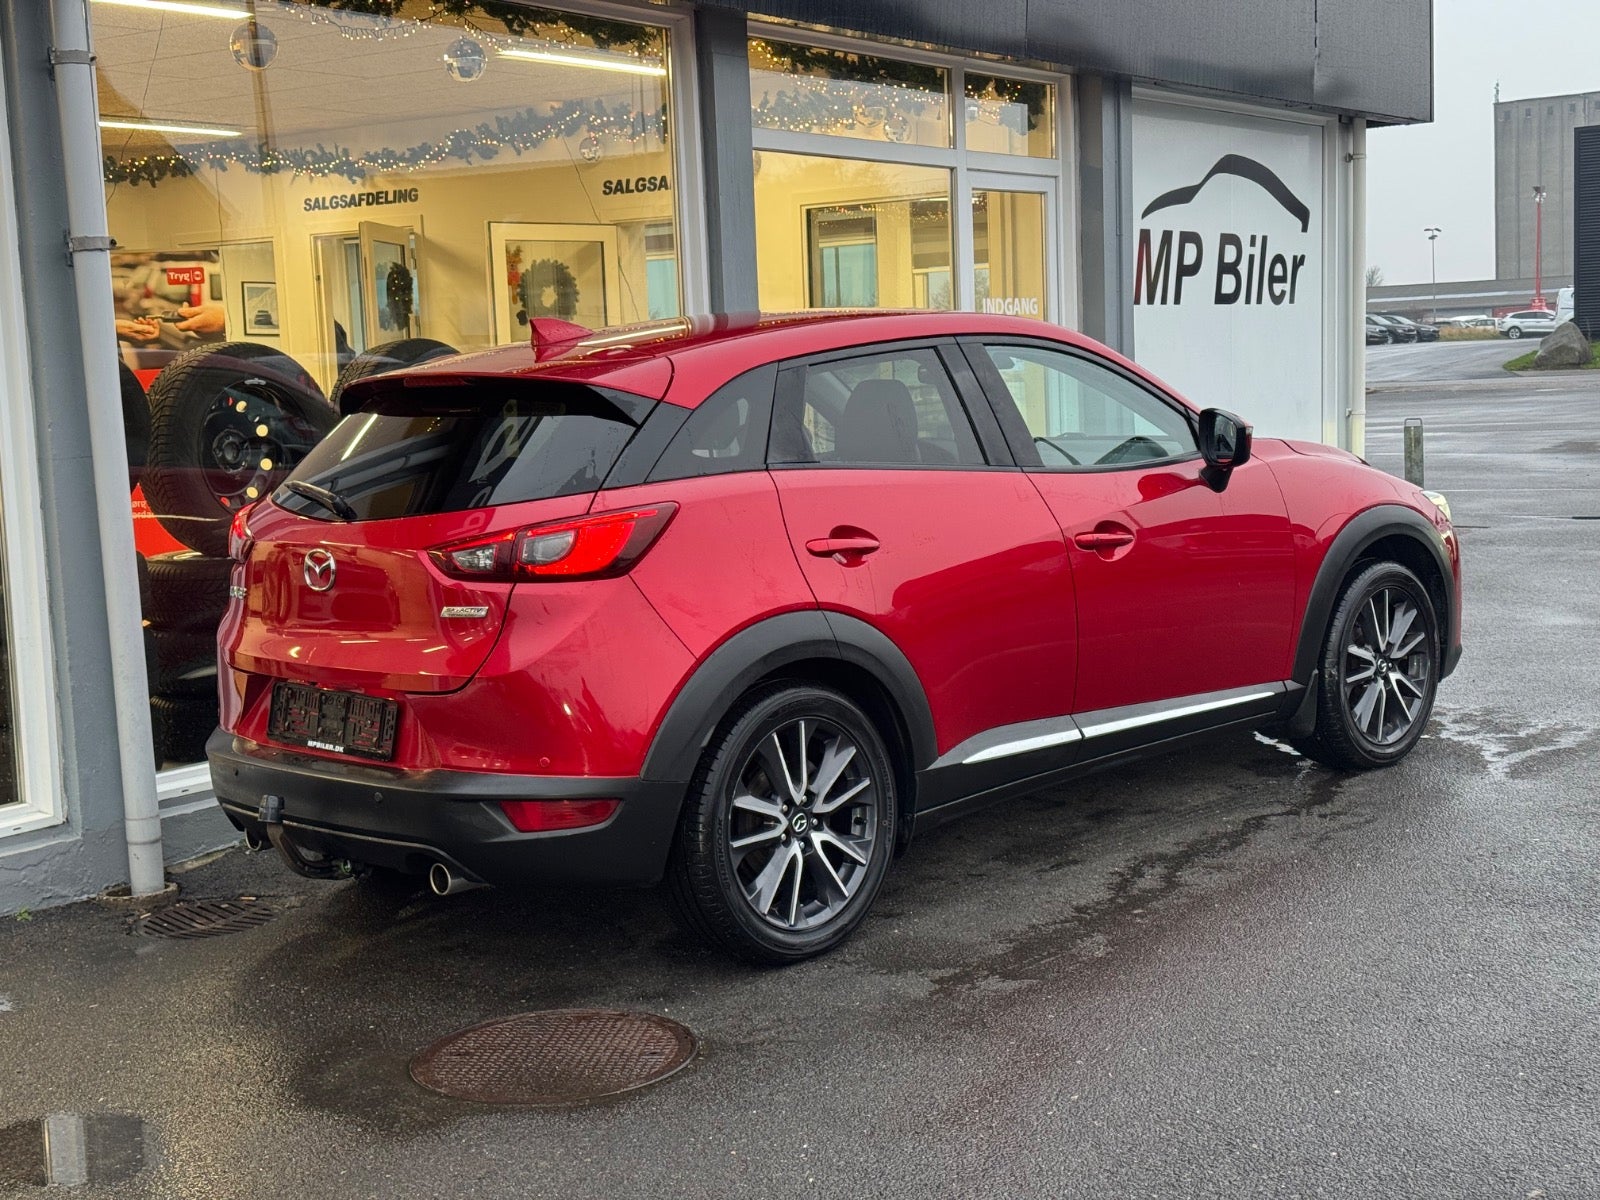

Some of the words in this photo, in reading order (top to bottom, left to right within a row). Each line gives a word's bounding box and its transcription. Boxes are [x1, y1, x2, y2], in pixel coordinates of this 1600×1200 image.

[602, 175, 671, 195] SALGSA
[304, 188, 419, 212] SALGSAFDELING
[168, 271, 190, 282] Tryg
[1133, 228, 1204, 305] MP
[1214, 232, 1306, 306] Biler
[983, 297, 1039, 315] INDGANG
